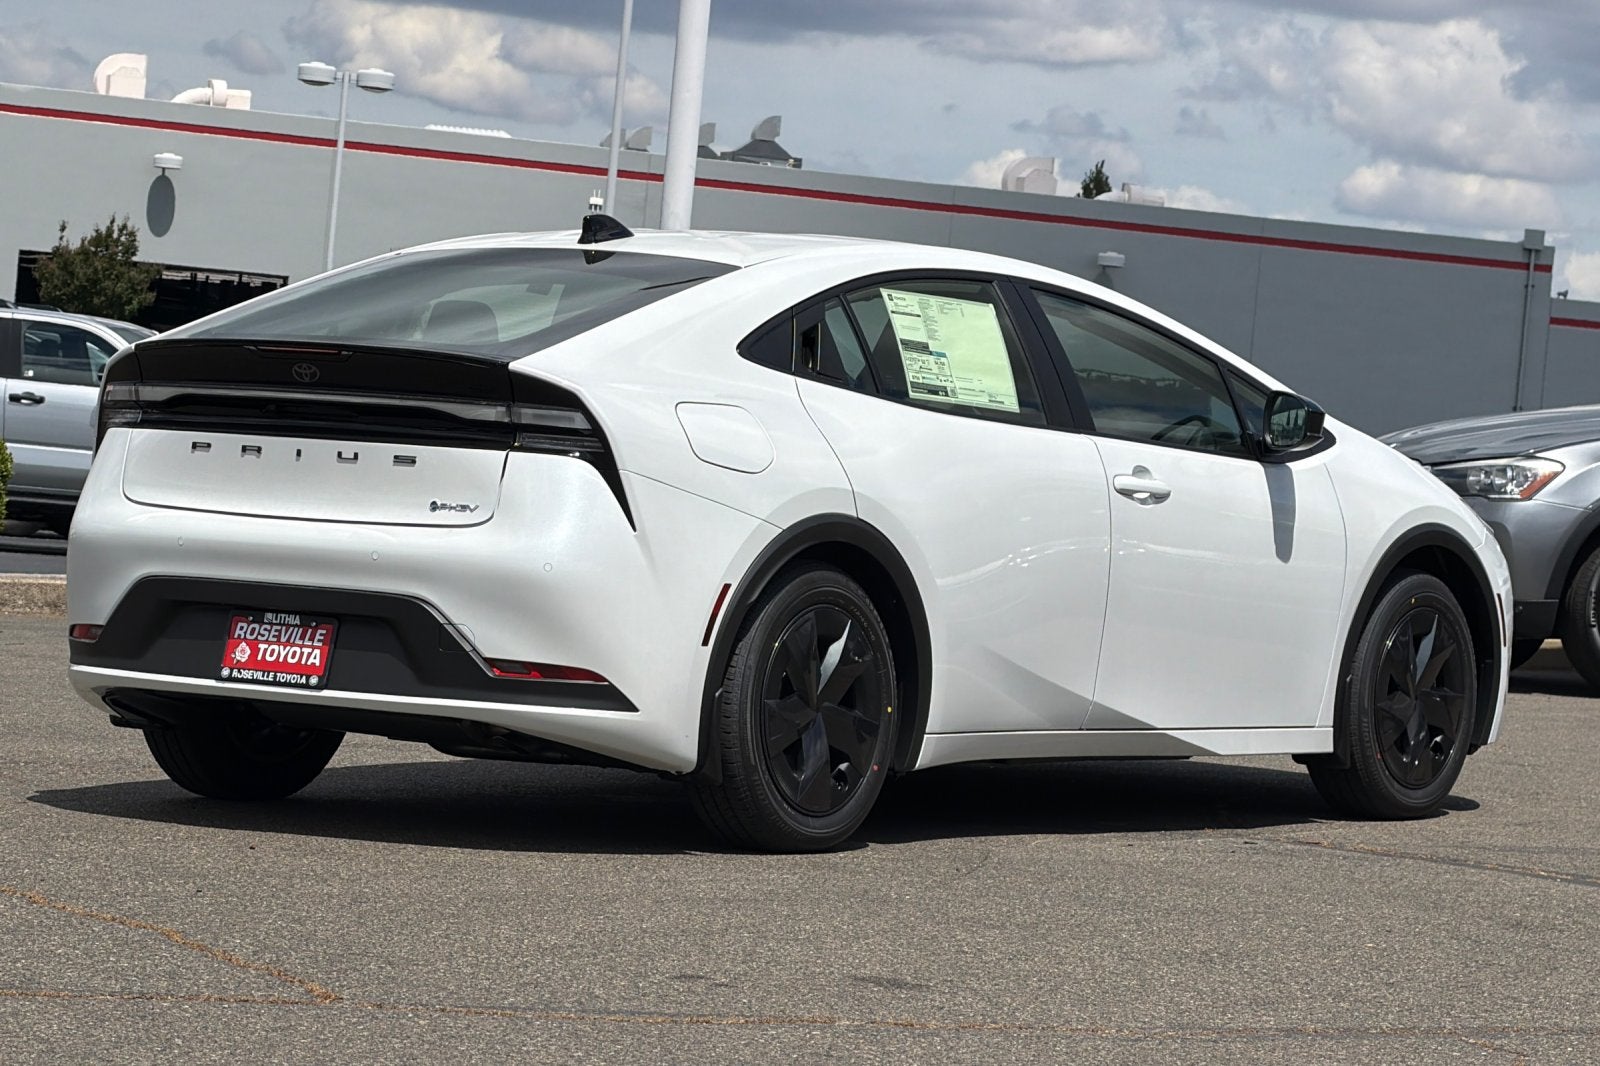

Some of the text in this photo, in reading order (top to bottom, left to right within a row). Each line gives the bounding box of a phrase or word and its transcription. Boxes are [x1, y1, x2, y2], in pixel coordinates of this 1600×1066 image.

[191, 442, 417, 465] PRIUS
[272, 613, 301, 625] LITHIA
[234, 622, 326, 646] ROSEVILLE
[256, 643, 321, 666] TOYOTA
[231, 669, 306, 684] ROSEVILLE TOYOTA
